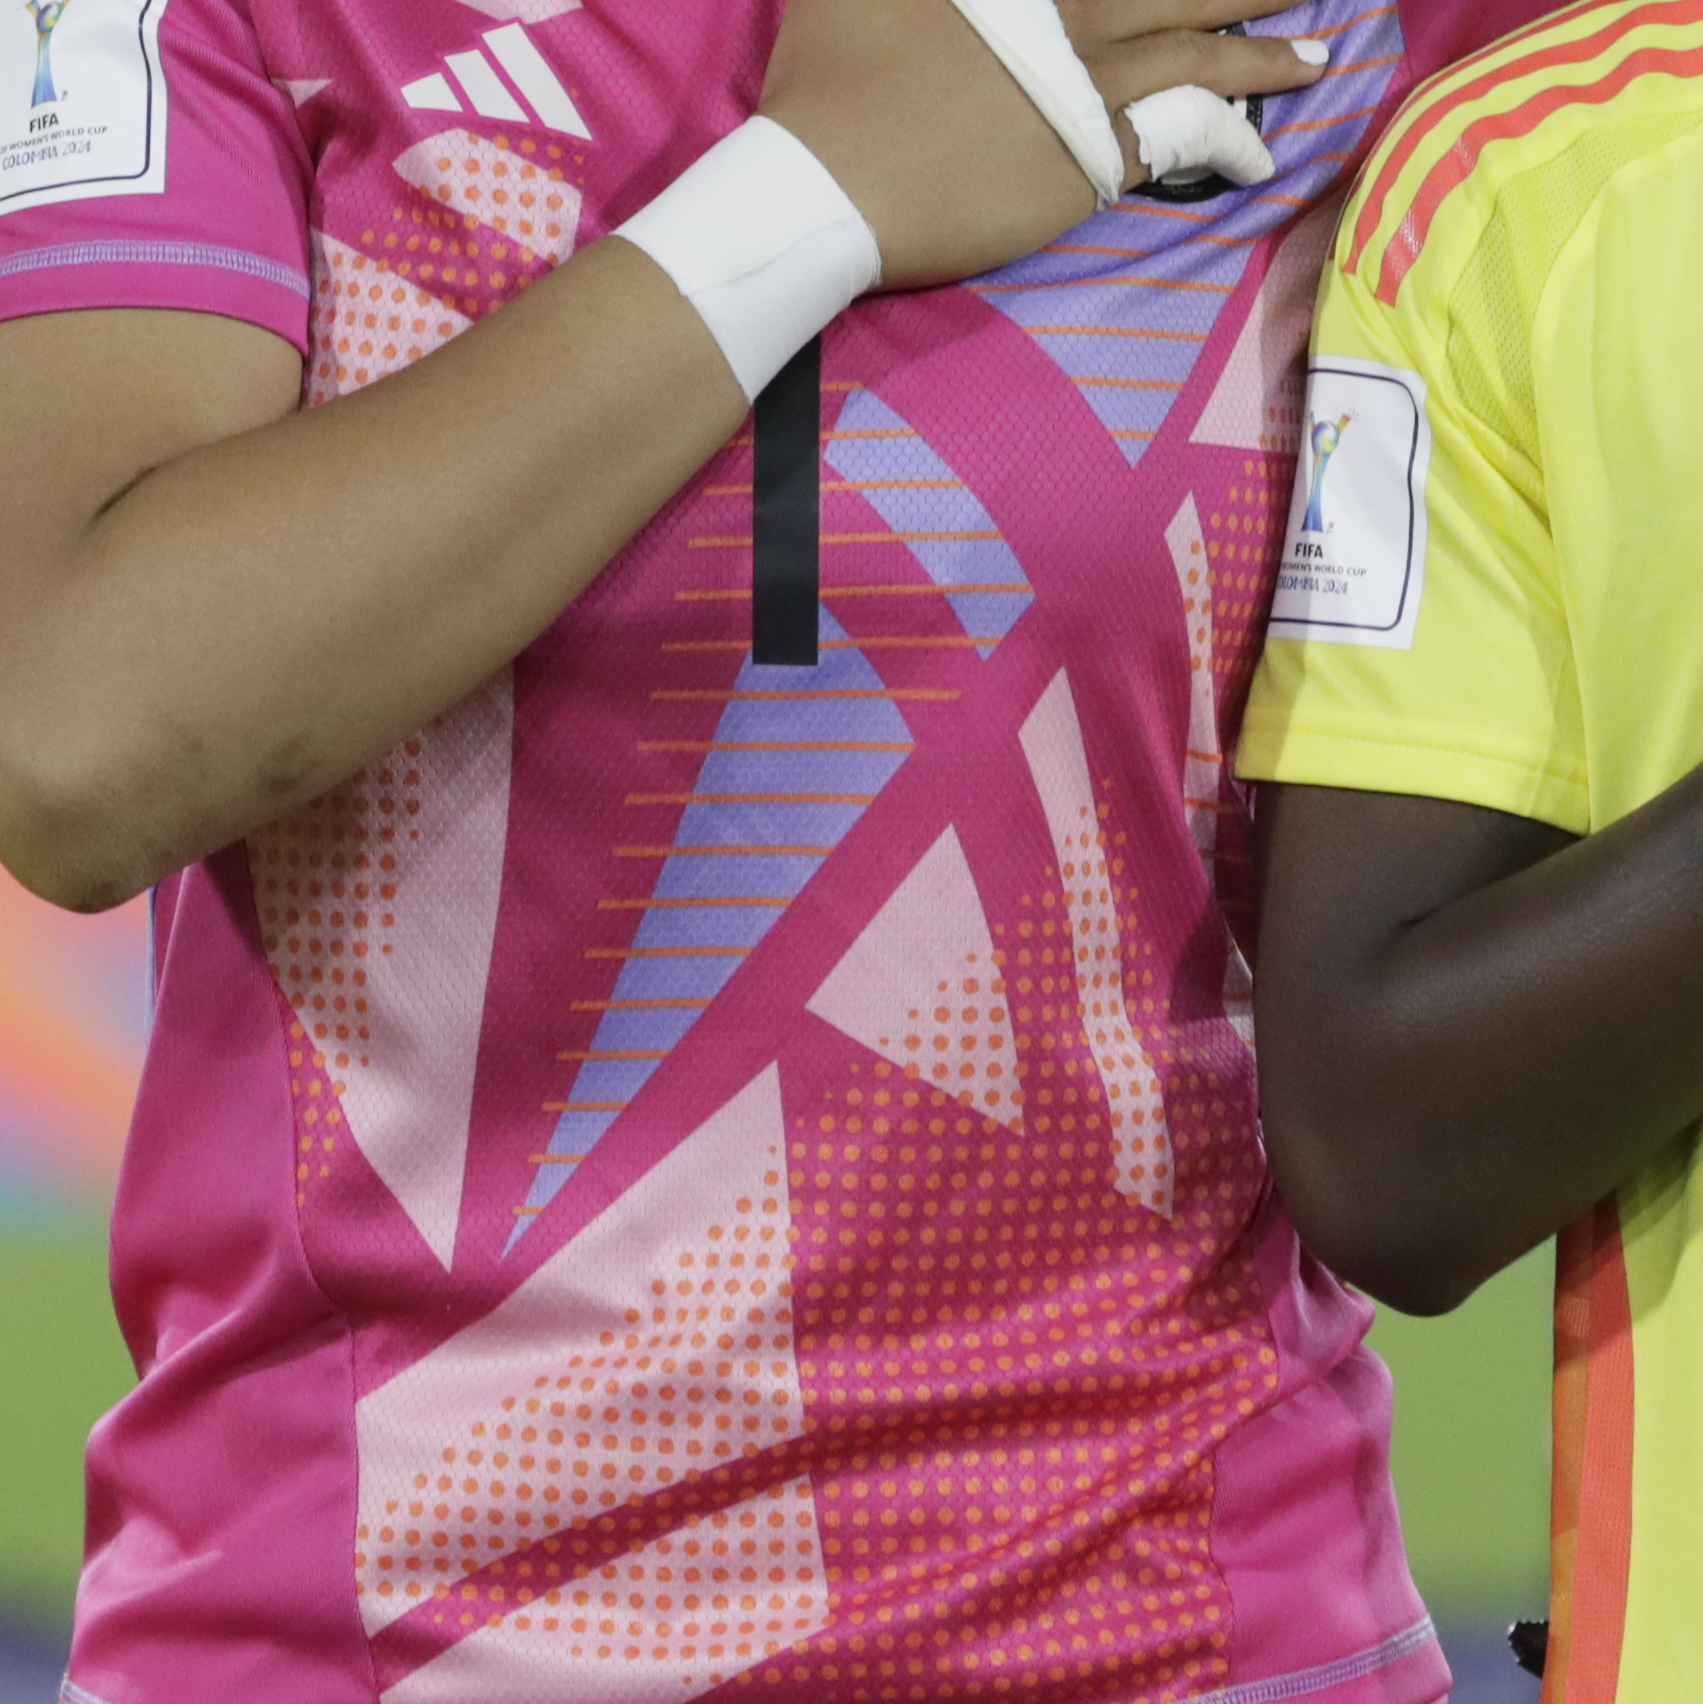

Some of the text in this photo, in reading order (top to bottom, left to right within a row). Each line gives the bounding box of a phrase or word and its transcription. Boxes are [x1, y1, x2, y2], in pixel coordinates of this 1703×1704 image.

[29, 112, 59, 134] FIFA
[9, 135, 49, 152] WOMEN'S
[50, 127, 84, 140] WORLD
[88, 126, 108, 135] CUP
[2, 140, 91, 170] COLOMBIA 2024
[1294, 542, 1323, 559] FIFA
[1314, 564, 1344, 574] WORLD
[1346, 567, 1367, 577] CUP
[1323, 579, 1349, 595] 2024
